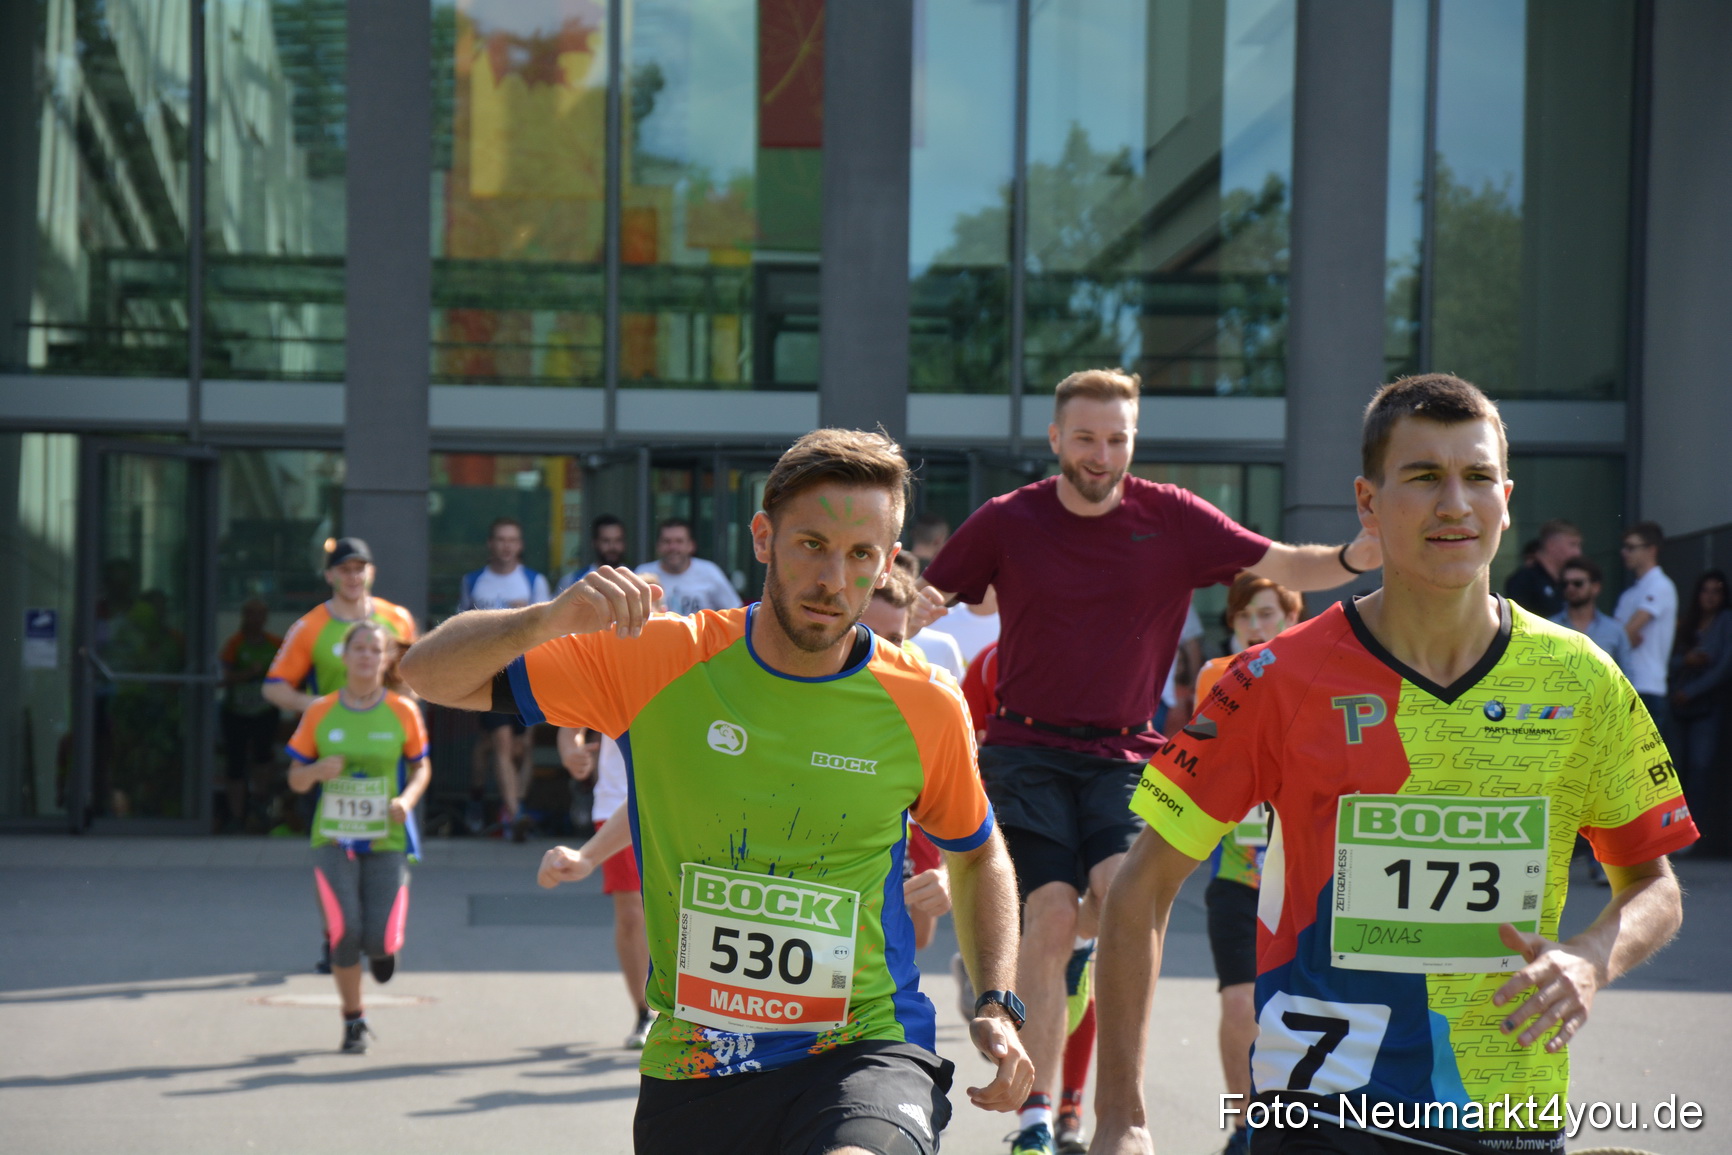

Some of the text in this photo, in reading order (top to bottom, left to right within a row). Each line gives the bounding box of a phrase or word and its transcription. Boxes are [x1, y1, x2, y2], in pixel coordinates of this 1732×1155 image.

[811, 751, 878, 775] BOCK
[336, 799, 372, 817] 119
[1353, 802, 1532, 844] BOCK
[1384, 859, 1500, 912] 173
[1527, 865, 1540, 874] E6
[693, 872, 842, 930] BOCK
[710, 926, 813, 985] 530
[1351, 924, 1423, 952] JONAS
[710, 988, 804, 1020] MARCO
[1281, 1010, 1350, 1091] 7
